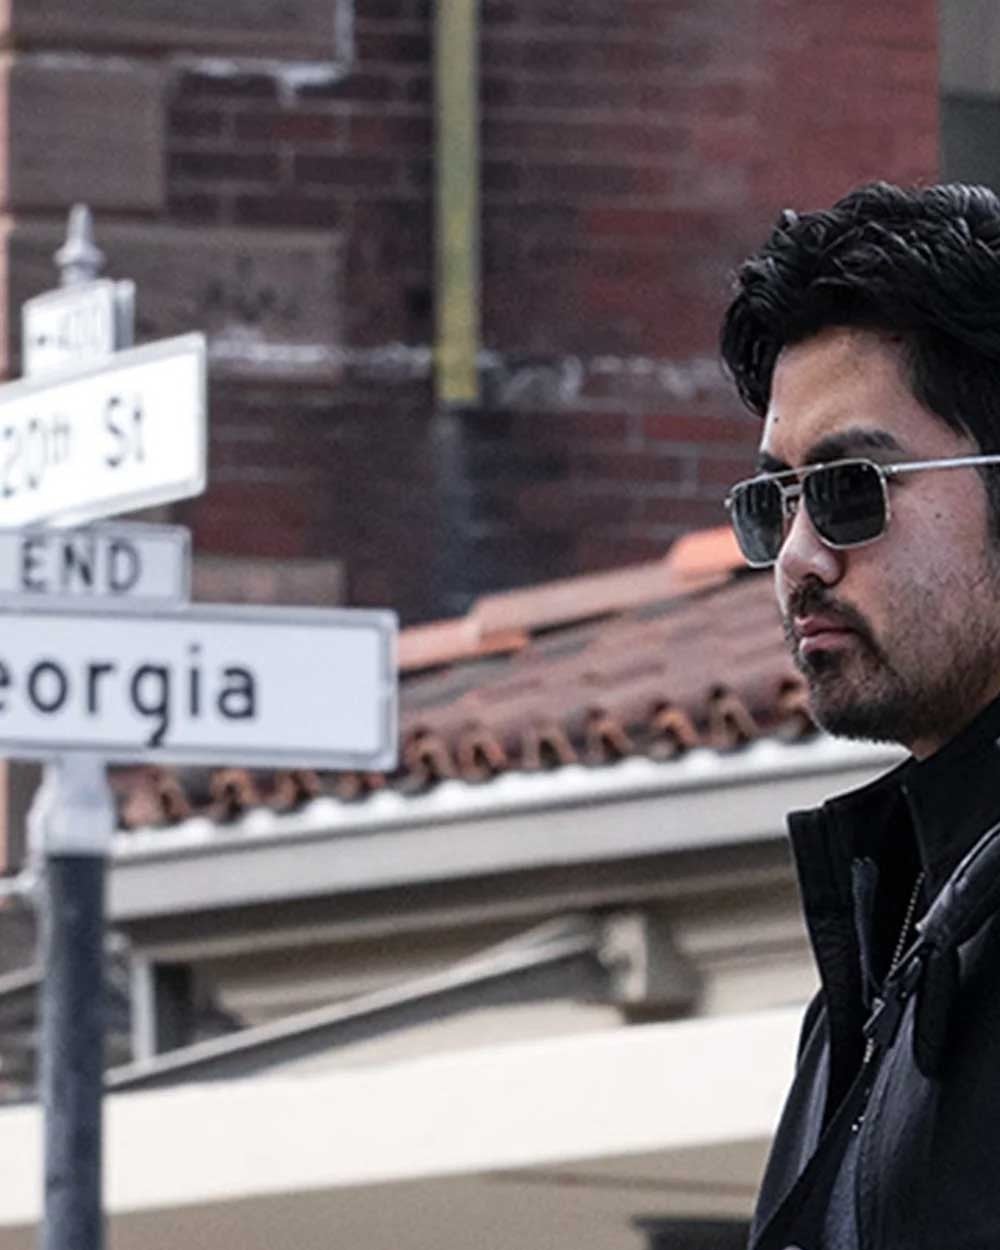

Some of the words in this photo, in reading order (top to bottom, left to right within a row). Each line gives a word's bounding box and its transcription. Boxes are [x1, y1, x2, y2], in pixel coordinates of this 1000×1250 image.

[104, 391, 146, 469] St
[21, 535, 142, 593] END
[0, 642, 257, 748] orgia
